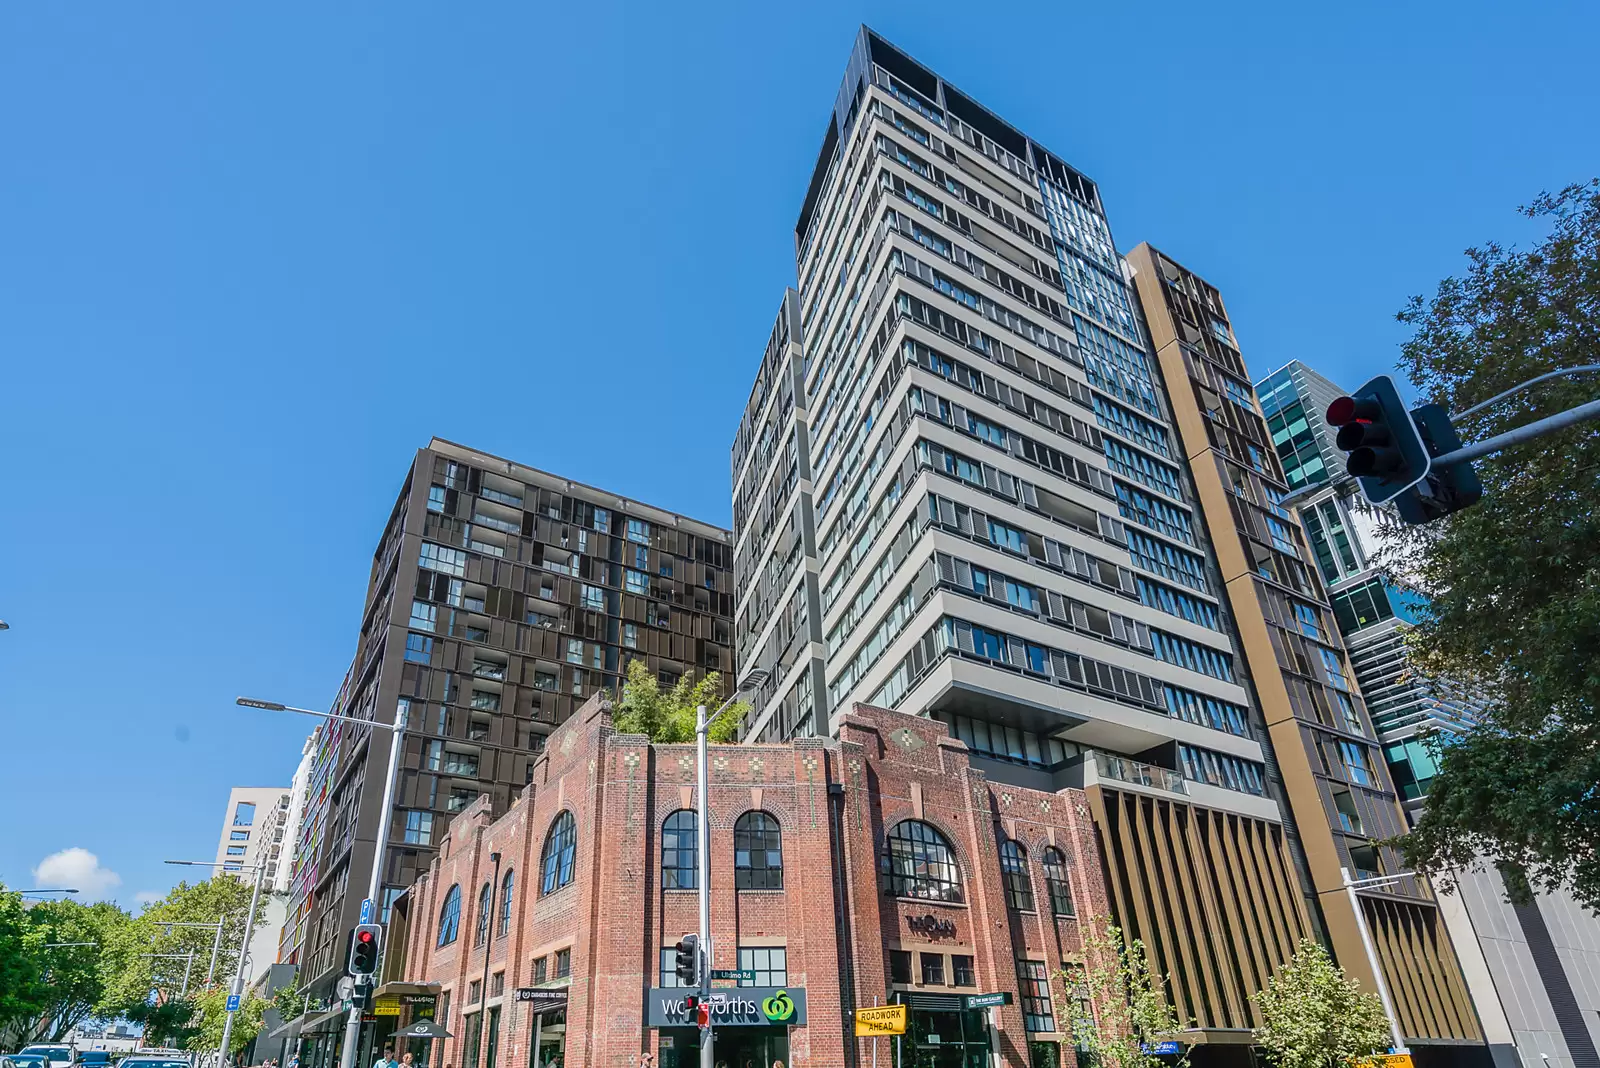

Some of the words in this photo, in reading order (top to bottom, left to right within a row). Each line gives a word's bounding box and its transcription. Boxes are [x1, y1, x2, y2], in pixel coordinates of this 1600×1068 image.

[363, 902, 369, 912] P
[661, 996, 756, 1015] woorths
[861, 1009, 901, 1021] ROADWORK
[868, 1022, 893, 1031] AHEAD
